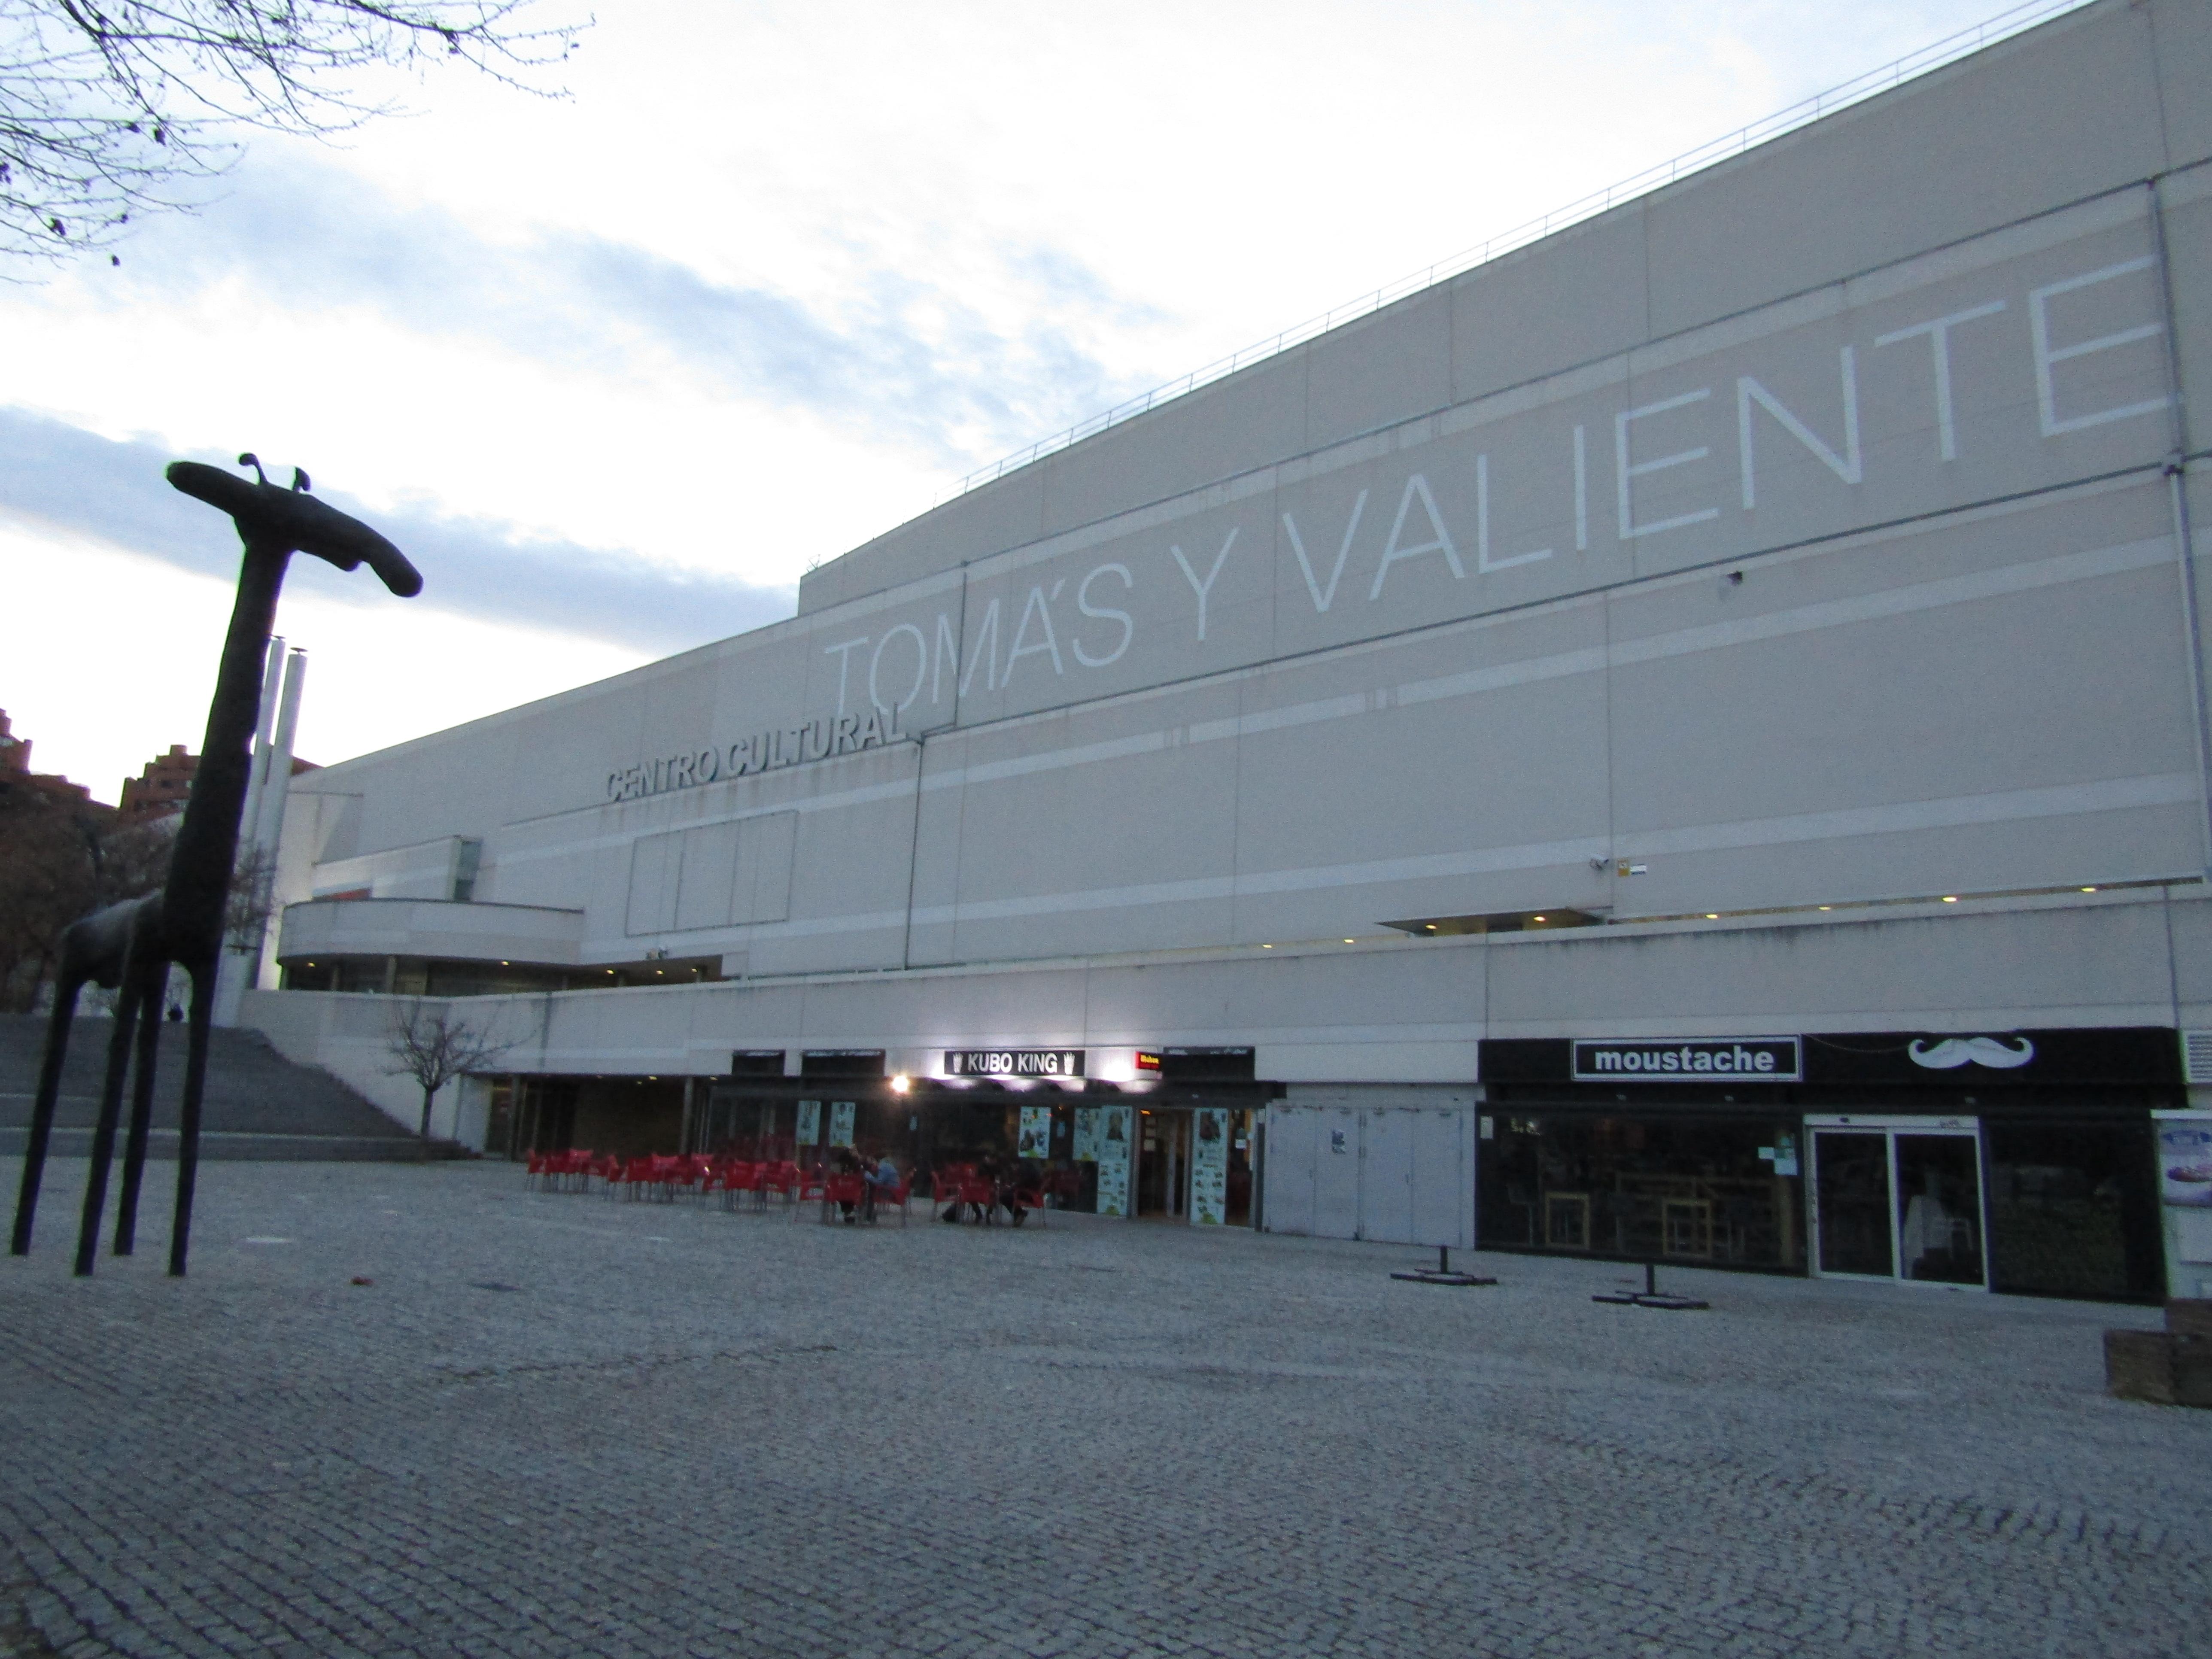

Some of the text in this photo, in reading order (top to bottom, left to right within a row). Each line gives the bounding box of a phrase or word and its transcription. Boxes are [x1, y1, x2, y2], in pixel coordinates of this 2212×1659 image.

[824, 255, 2172, 716] TOMÁS Y VALIENTE
[607, 702, 907, 803] CENTRO CULTURAL
[967, 1053, 1058, 1073] KUBO KING
[1594, 1045, 1775, 1072] moustache
